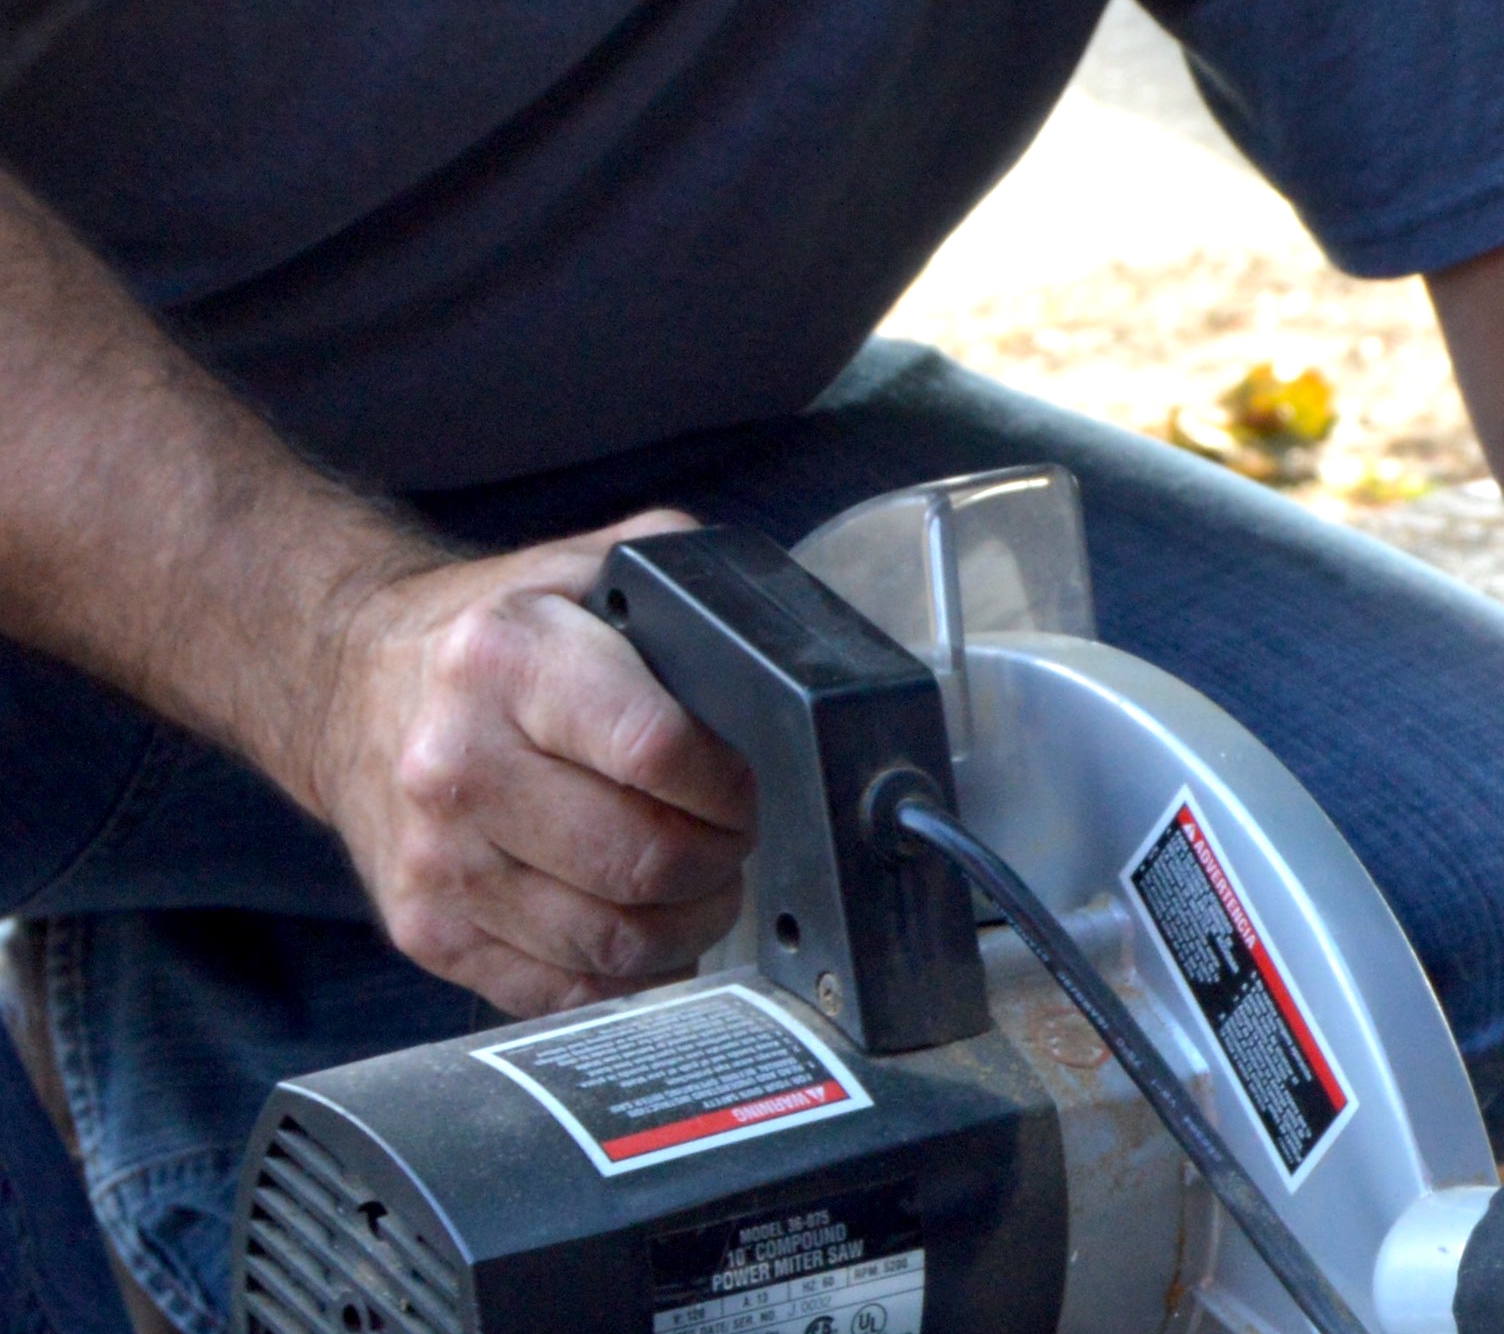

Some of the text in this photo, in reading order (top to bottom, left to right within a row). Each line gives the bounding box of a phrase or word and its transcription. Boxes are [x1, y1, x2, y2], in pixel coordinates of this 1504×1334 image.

[1193, 838, 1256, 949] ADVERTENCIA
[730, 1090, 810, 1122] WARNING
[739, 1222, 784, 1243] MODEL
[755, 1223, 848, 1262] COMPOUND
[712, 1240, 864, 1292] POWER MITER SAW
